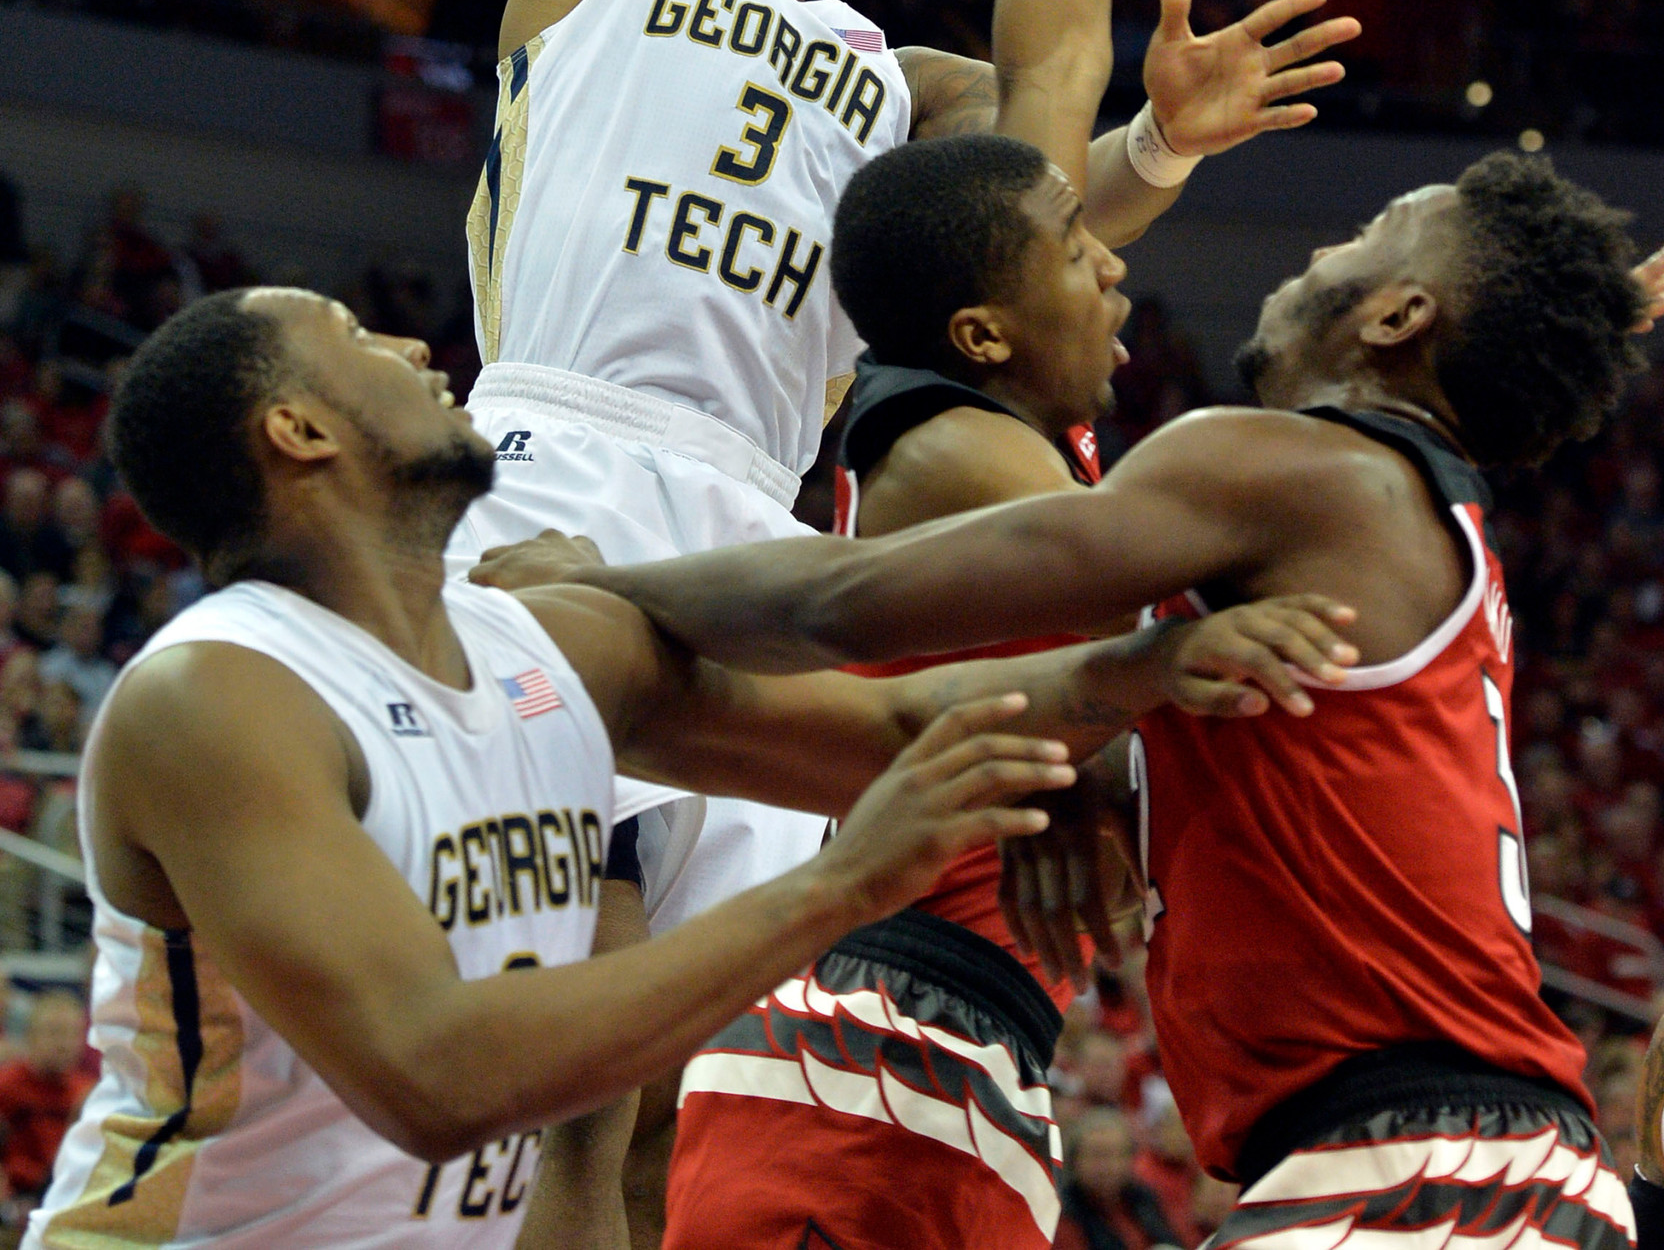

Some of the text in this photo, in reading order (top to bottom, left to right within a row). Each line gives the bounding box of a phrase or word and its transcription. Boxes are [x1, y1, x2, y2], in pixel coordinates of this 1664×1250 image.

[708, 79, 794, 187] 3
[622, 175, 826, 321] TECH
[494, 452, 535, 462] USSELL
